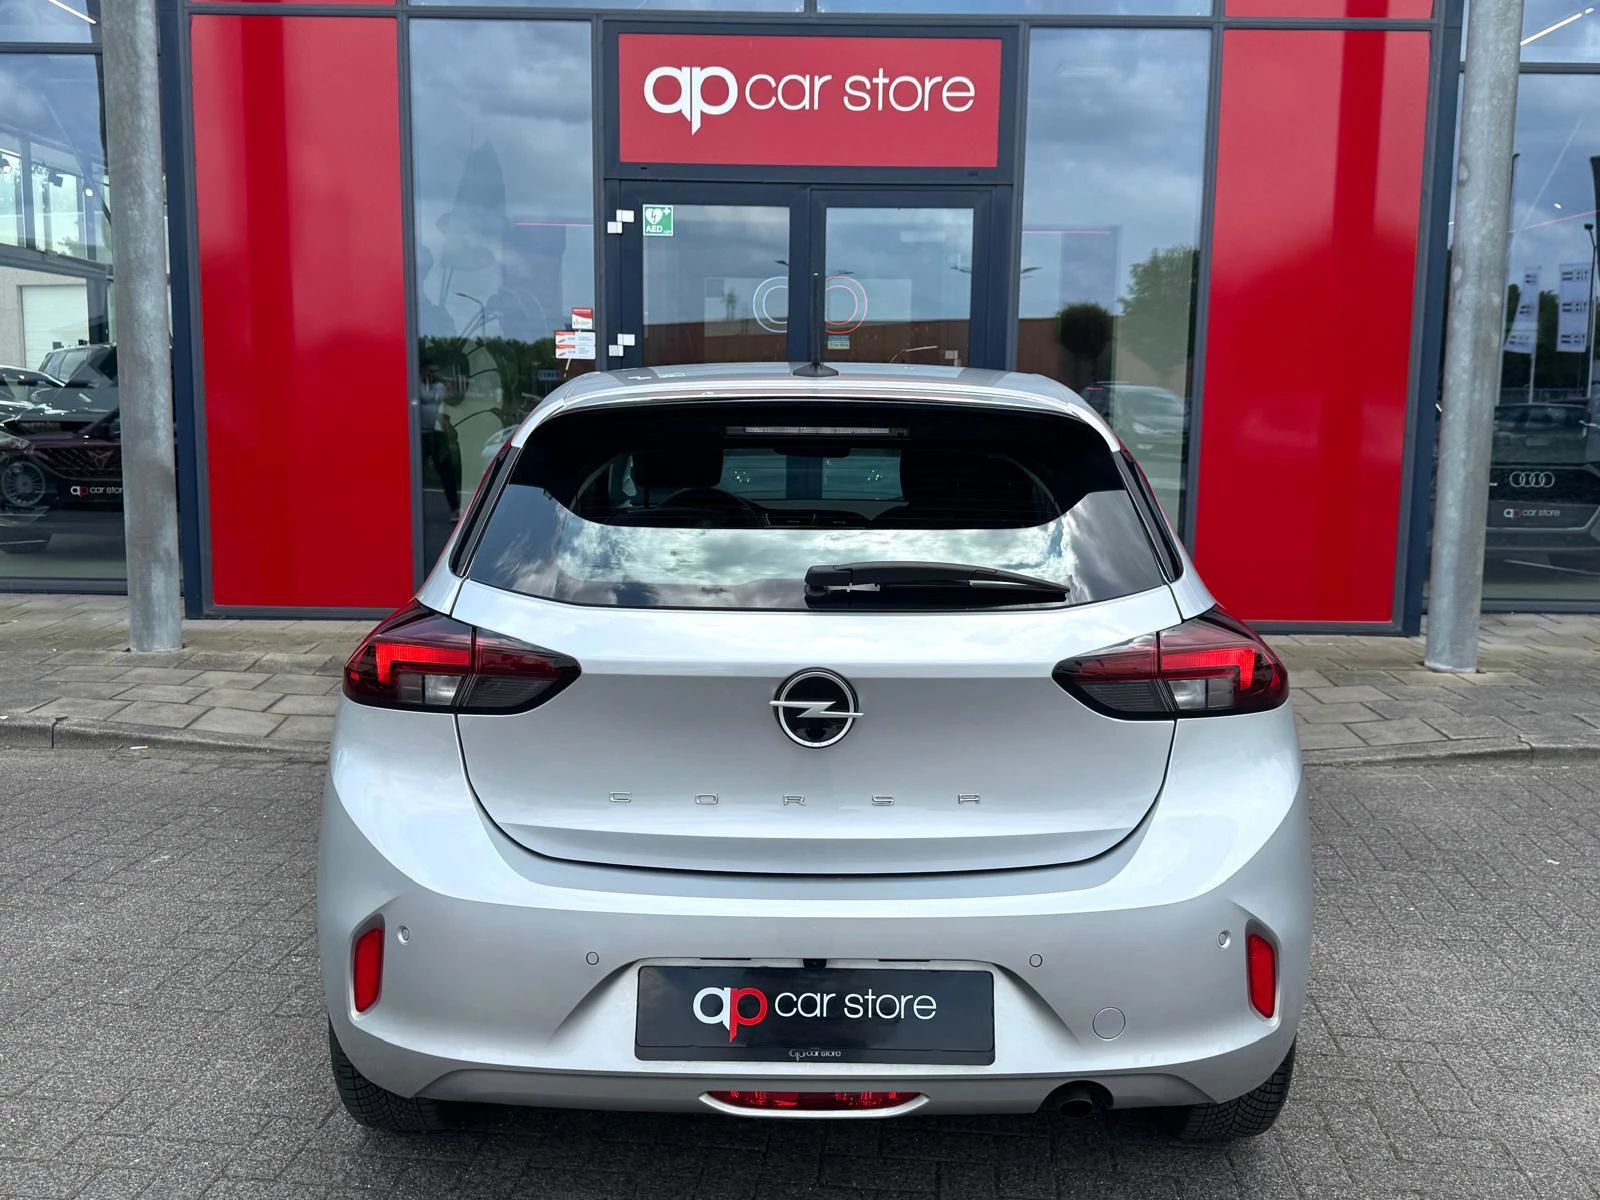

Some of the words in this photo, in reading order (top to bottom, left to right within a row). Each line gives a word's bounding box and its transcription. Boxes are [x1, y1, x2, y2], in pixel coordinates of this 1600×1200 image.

[643, 66, 739, 136] ap
[745, 73, 833, 111] car
[843, 67, 976, 113] store
[645, 225, 663, 233] AED
[106, 486, 123, 494] stor
[608, 791, 981, 807] CORSA
[692, 986, 768, 1043] ap
[774, 992, 837, 1018] car
[843, 987, 937, 1020] store
